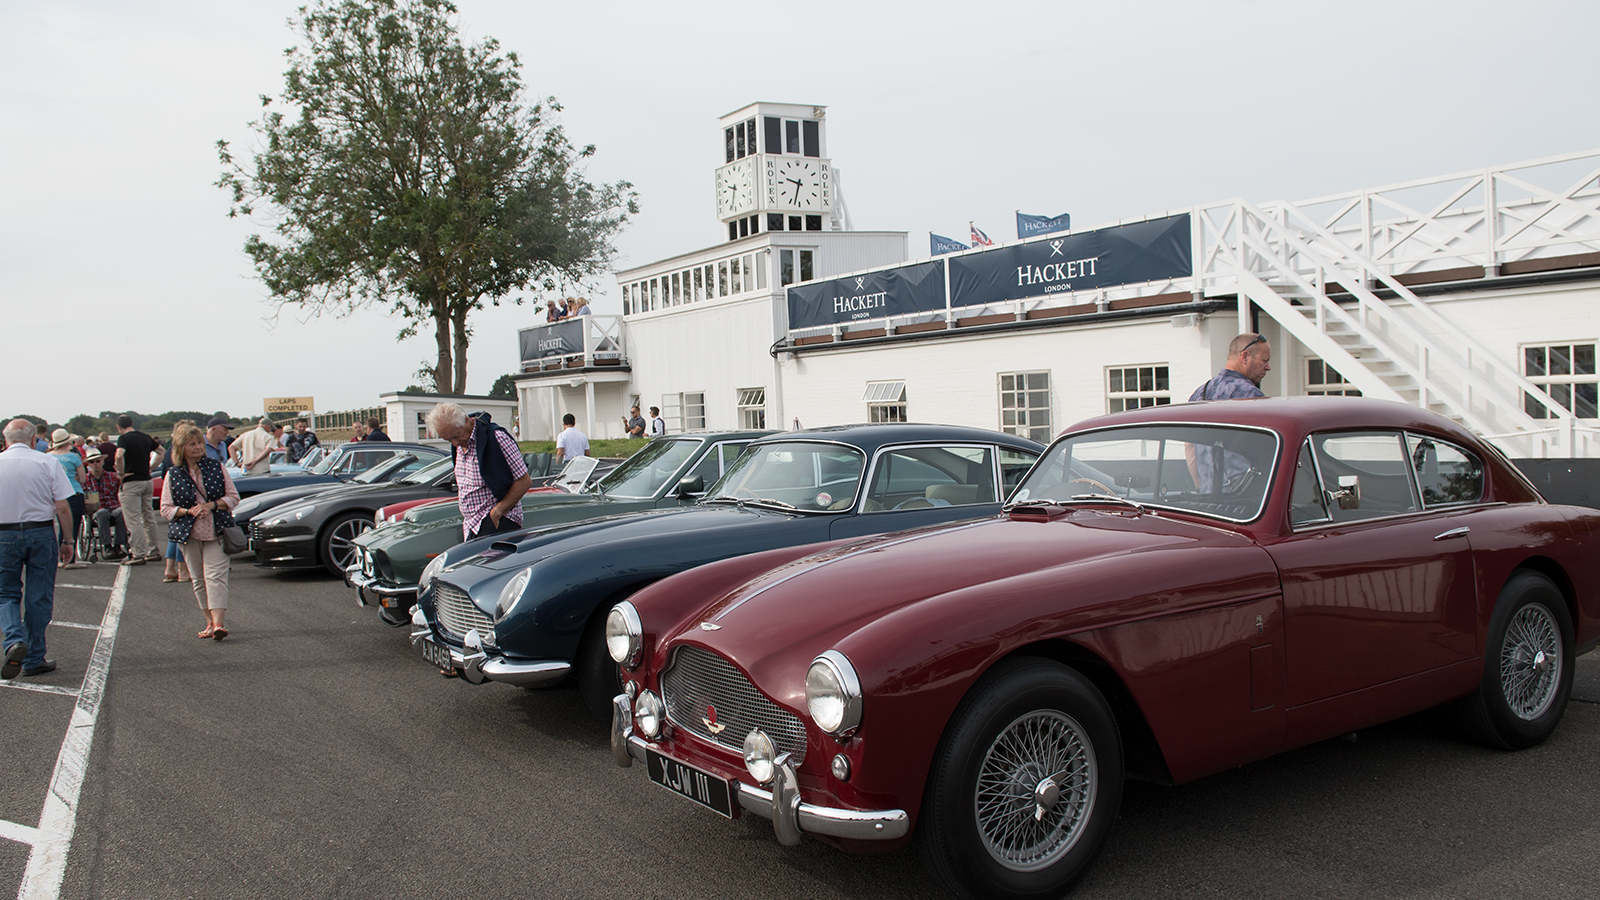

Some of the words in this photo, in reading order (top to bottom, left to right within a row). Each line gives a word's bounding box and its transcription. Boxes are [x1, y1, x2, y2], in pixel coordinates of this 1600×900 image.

[767, 160, 776, 204] ROLEX
[821, 164, 830, 206] ROLEX
[1017, 257, 1099, 286] HACKETT
[1044, 283, 1072, 293] LONDON
[833, 291, 887, 314] HACKETT
[851, 312, 870, 320] LONDON
[538, 337, 563, 351] HACKETT
[659, 757, 692, 796] XJW
